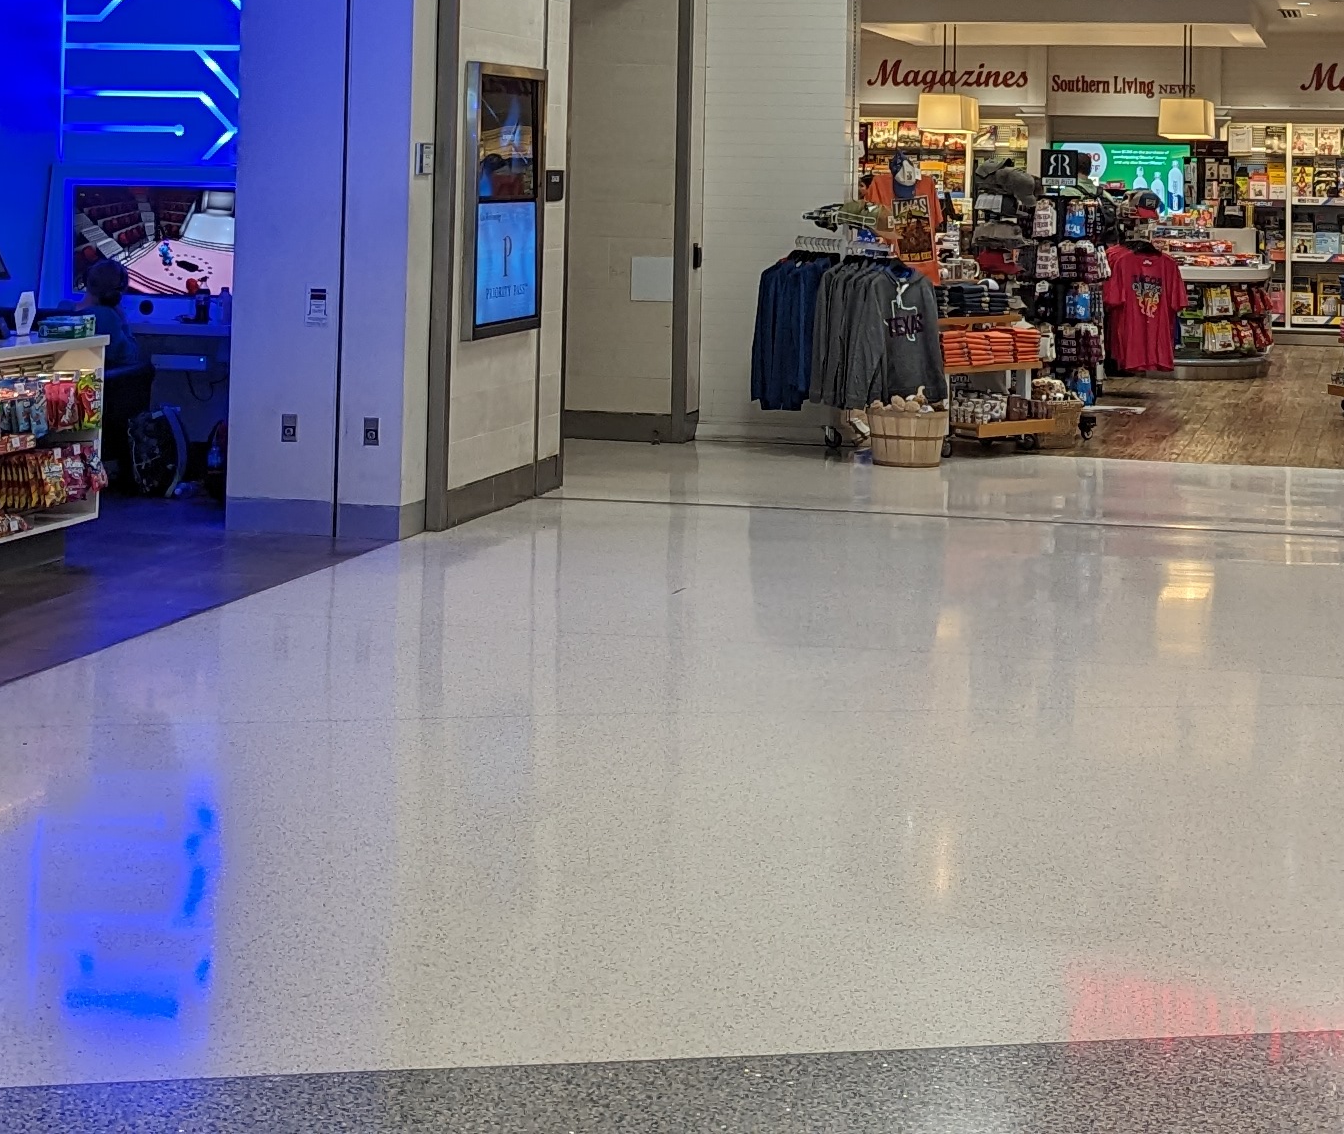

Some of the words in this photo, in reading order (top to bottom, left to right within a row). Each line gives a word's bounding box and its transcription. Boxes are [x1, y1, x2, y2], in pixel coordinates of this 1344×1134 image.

[867, 59, 1029, 93] Magazines
[1051, 74, 1110, 95] Southern
[1113, 76, 1155, 98] Living
[1159, 83, 1196, 95] NEWS
[893, 198, 927, 218] TEXAS
[485, 286, 511, 300] PRIORITY
